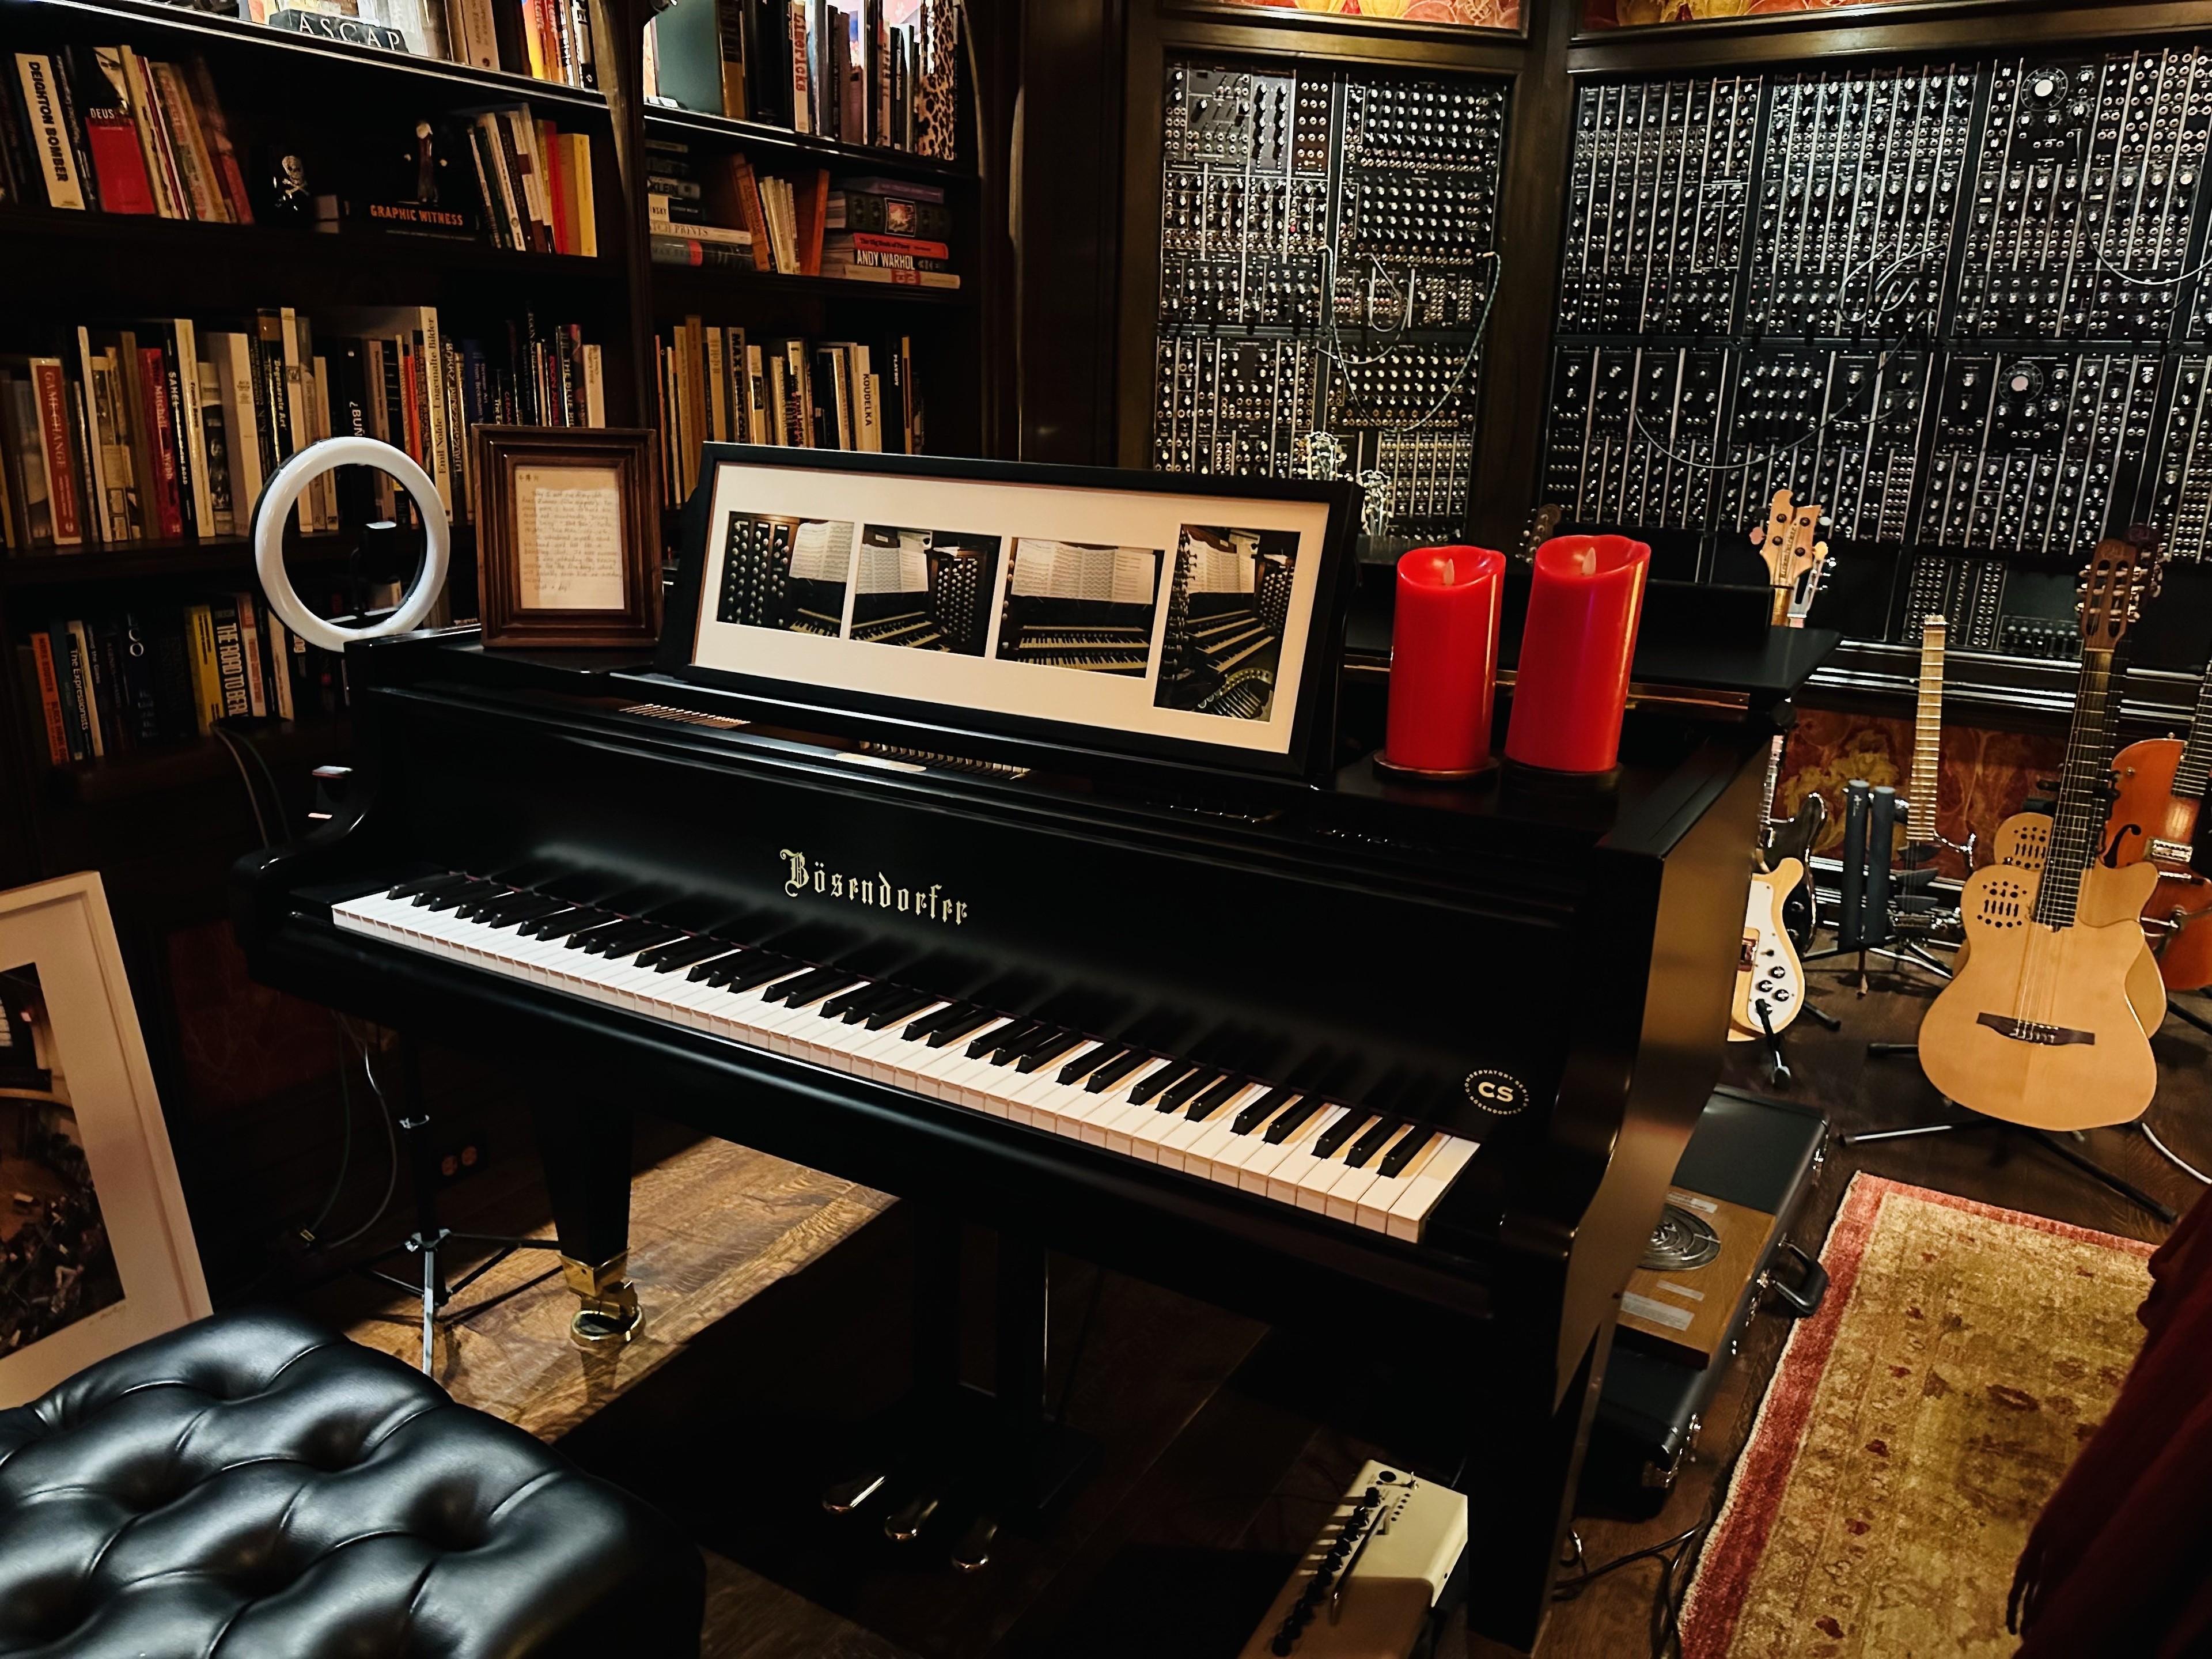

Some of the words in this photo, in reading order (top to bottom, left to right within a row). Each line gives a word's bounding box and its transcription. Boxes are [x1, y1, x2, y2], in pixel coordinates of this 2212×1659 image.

[298, 13, 400, 51] ASCAP
[793, 13, 808, 92] Limericks
[28, 61, 55, 124] DEIGHTON
[45, 127, 69, 183] BOMBER
[89, 107, 115, 120] DEUS
[370, 204, 416, 221] GRAPHIC
[418, 209, 464, 226] WITNESS
[674, 225, 709, 237] PRINTS
[857, 249, 879, 266] ANDY
[881, 253, 916, 271] WARHOL
[426, 317, 437, 350] Bilder
[732, 333, 742, 368] MAX
[43, 371, 59, 408] GAME
[168, 370, 181, 406] SAHEL
[188, 382, 198, 407] Francis
[475, 381, 483, 415] Beckmann
[565, 381, 574, 409] BLUE
[863, 373, 872, 426] KOUDELKA
[49, 412, 67, 469] CHANGE
[153, 385, 169, 429] Mitchell
[162, 453, 173, 480] Webb
[434, 418, 445, 448] Nolde
[437, 450, 448, 475] Emil
[38, 637, 48, 660] MARK
[216, 622, 238, 645] THE
[70, 648, 80, 667] The
[219, 643, 243, 675] ROAD
[224, 674, 244, 689] TO
[51, 701, 62, 724] BLACK
[72, 668, 89, 731] Expressionists
[53, 725, 65, 747] HAWK
[779, 849, 968, 925] Bösendorfer
[1478, 1081, 1514, 1103] CS
